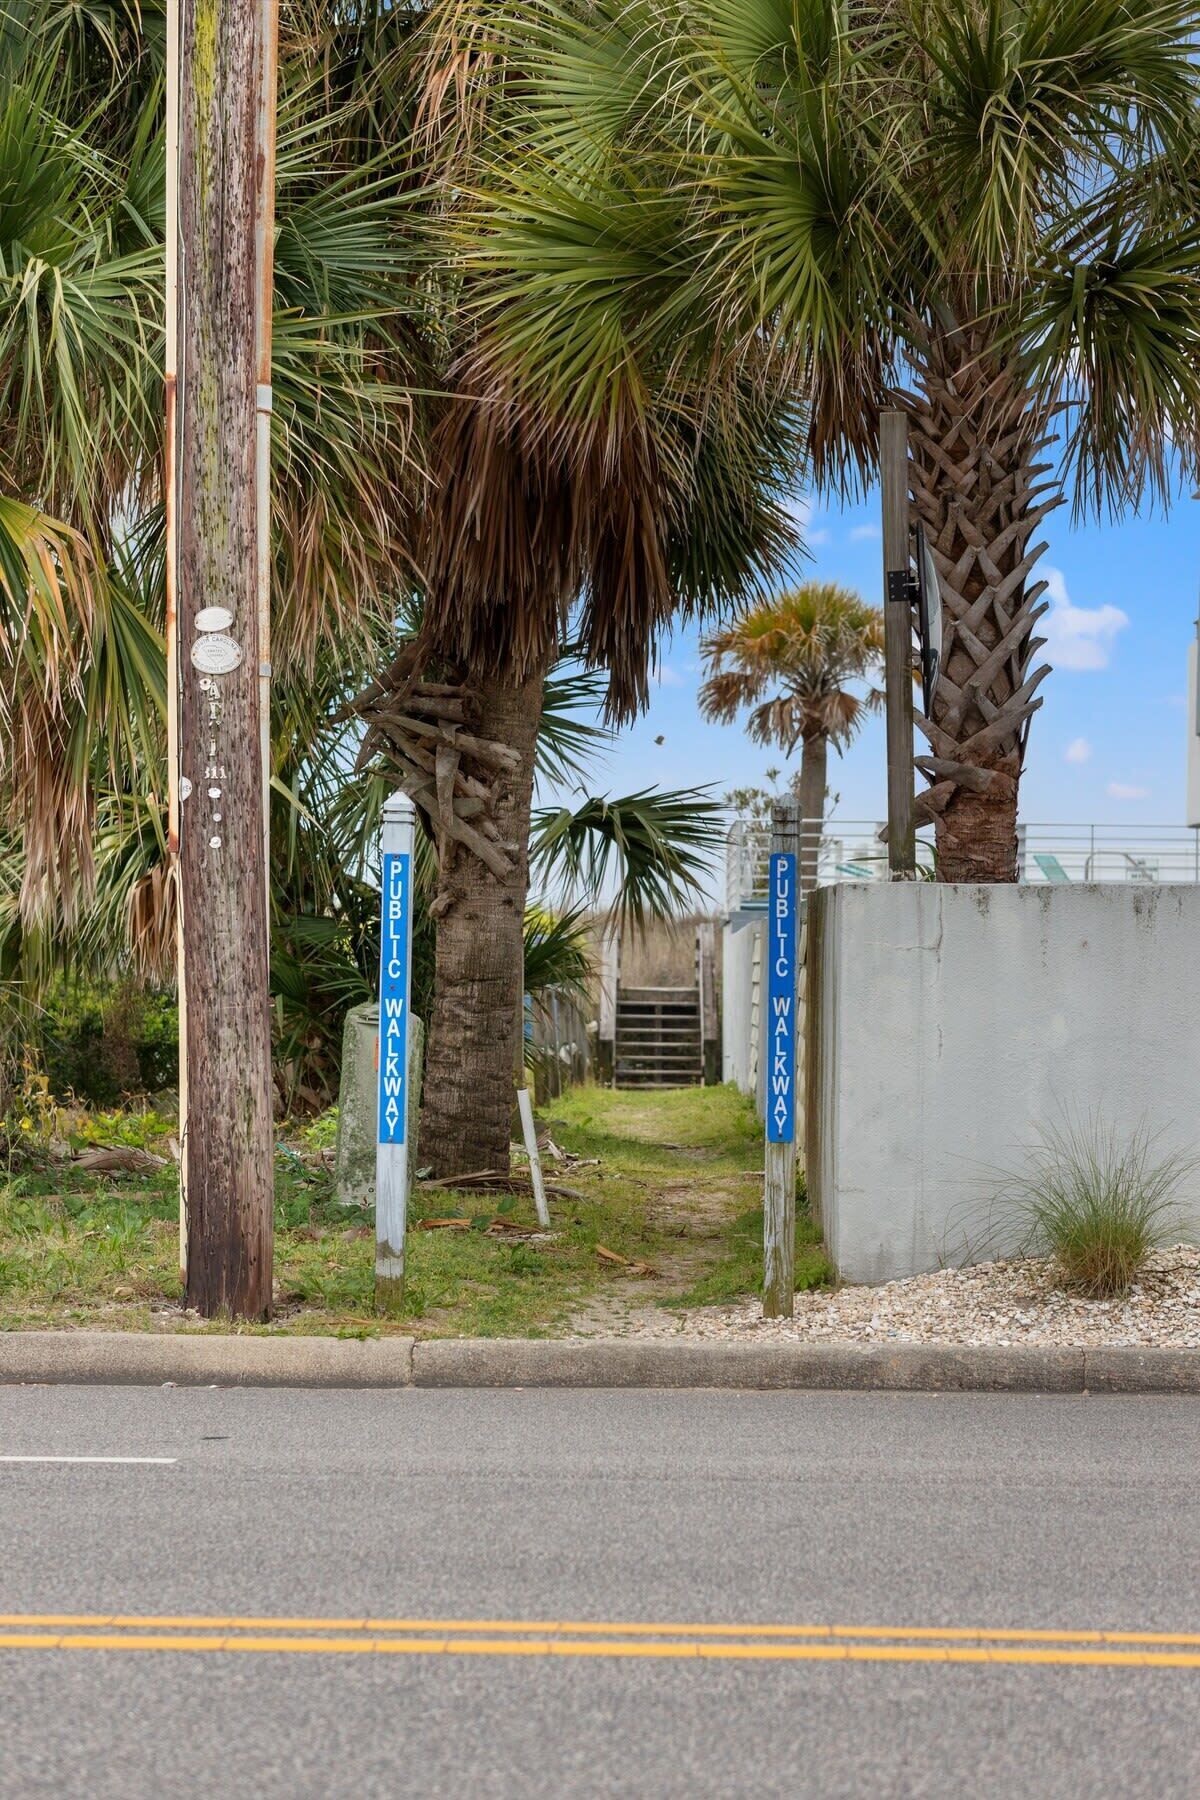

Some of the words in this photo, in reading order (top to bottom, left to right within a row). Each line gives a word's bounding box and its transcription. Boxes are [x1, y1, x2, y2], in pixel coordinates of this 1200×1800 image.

[388, 861, 402, 979] PUBLIC
[775, 859, 789, 978] PUBLIC
[384, 998, 403, 1136] WALKWAY
[772, 997, 791, 1134] WALKWAY
